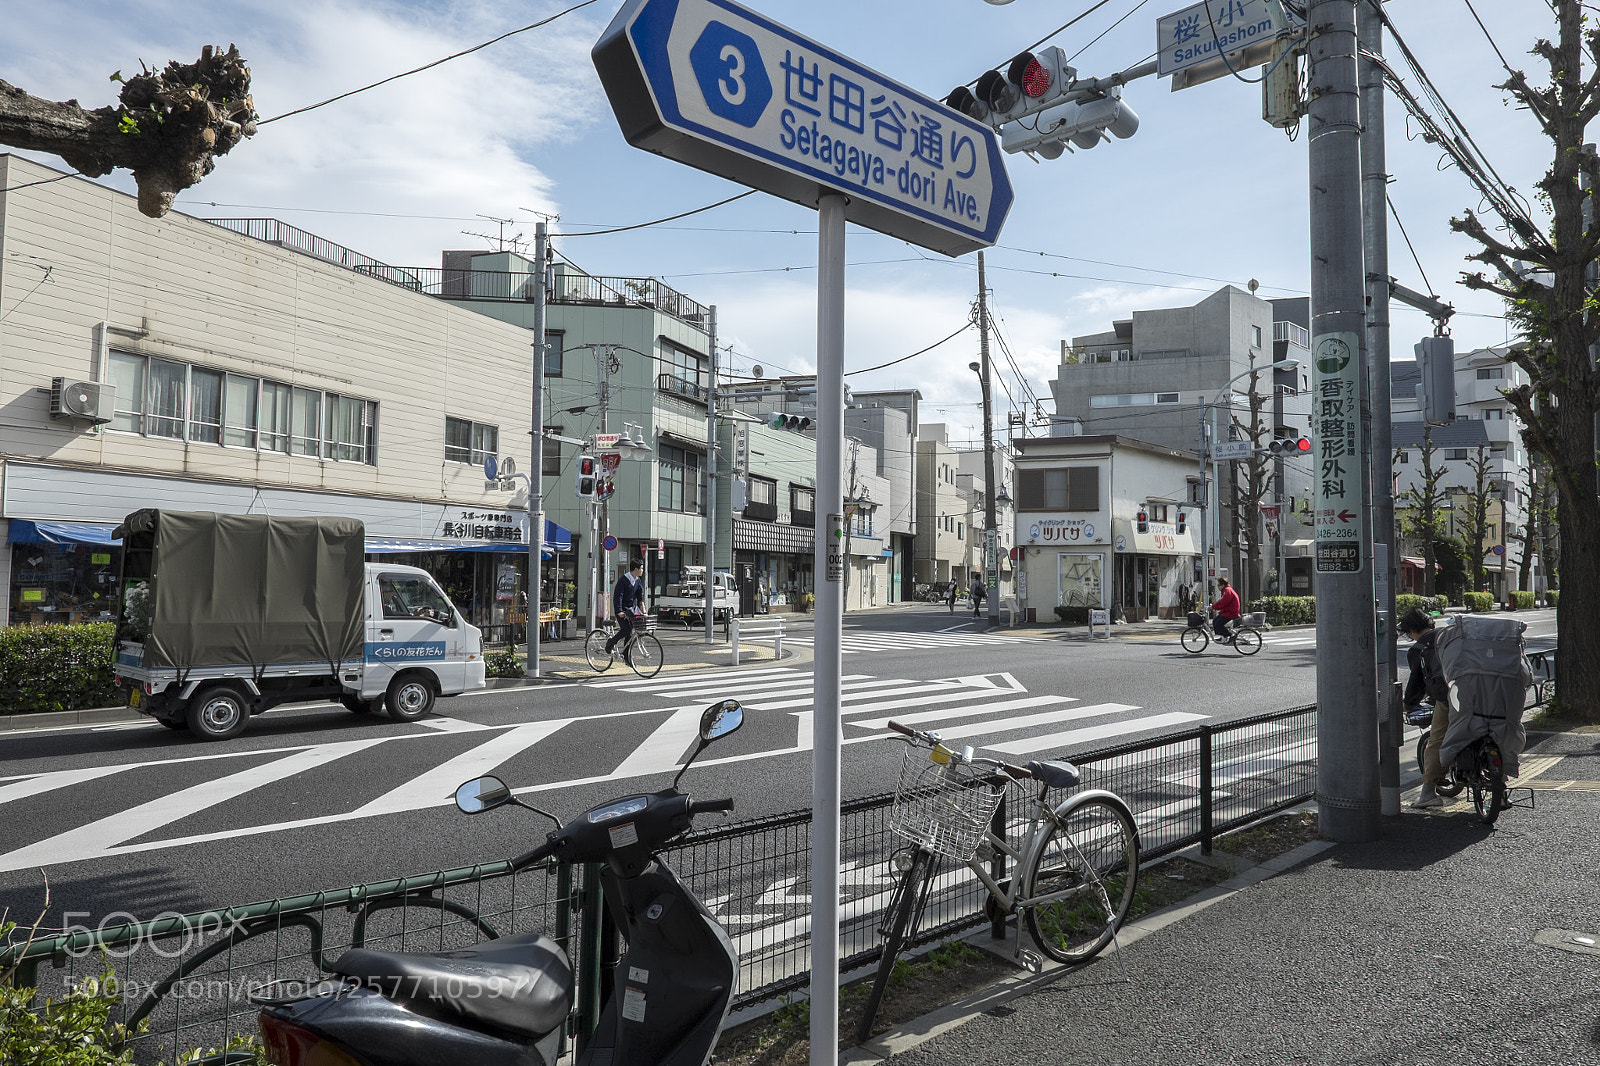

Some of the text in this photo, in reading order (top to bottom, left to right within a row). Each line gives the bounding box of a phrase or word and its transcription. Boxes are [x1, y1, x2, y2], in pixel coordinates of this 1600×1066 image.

[717, 44, 747, 106] 3
[780, 49, 977, 179] 世田谷通り
[780, 109, 982, 222] Setagaya-dori Ave.
[1320, 378, 1346, 499] 香取整形外科
[442, 521, 523, 541] 長谷川自転車商会
[374, 646, 443, 658] くらしの友花だん
